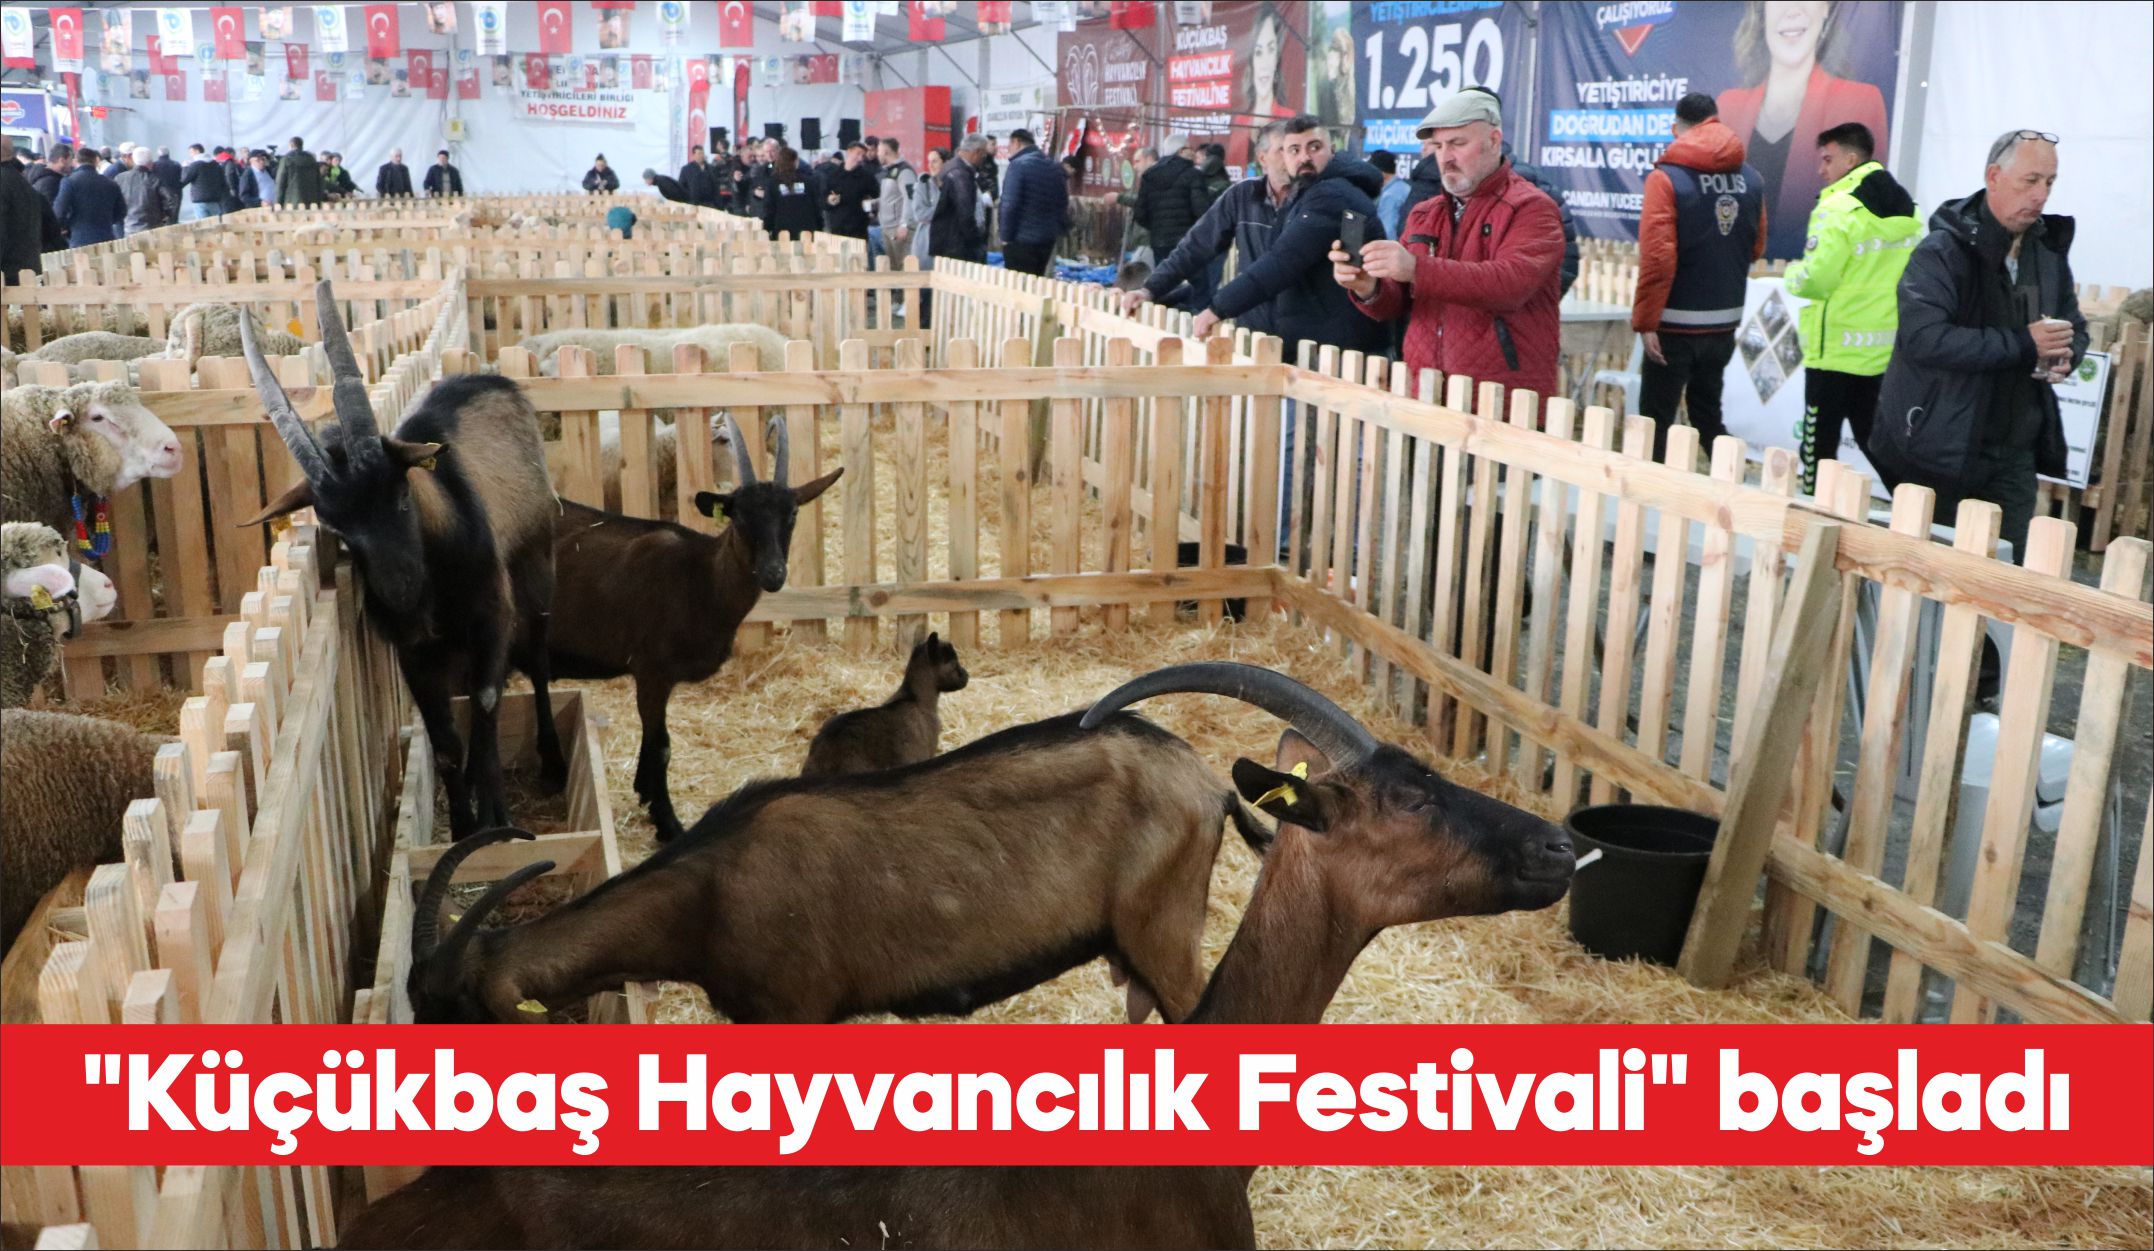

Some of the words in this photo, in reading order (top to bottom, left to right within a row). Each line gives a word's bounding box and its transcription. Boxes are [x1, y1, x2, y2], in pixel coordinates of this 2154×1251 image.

[1175, 24, 1228, 54] KÜÇÜKBAŞ
[1169, 54, 1231, 79] HAYVANCILIK
[1365, 17, 1504, 110] 1.250
[1576, 73, 1688, 109] YETİŞTİRİCİYE
[1366, 119, 1421, 149] KÜÇÜKB
[1552, 109, 1644, 136] DOĞRUDAN
[1647, 113, 1677, 136] DES
[1541, 146, 1606, 168] KIRSALA
